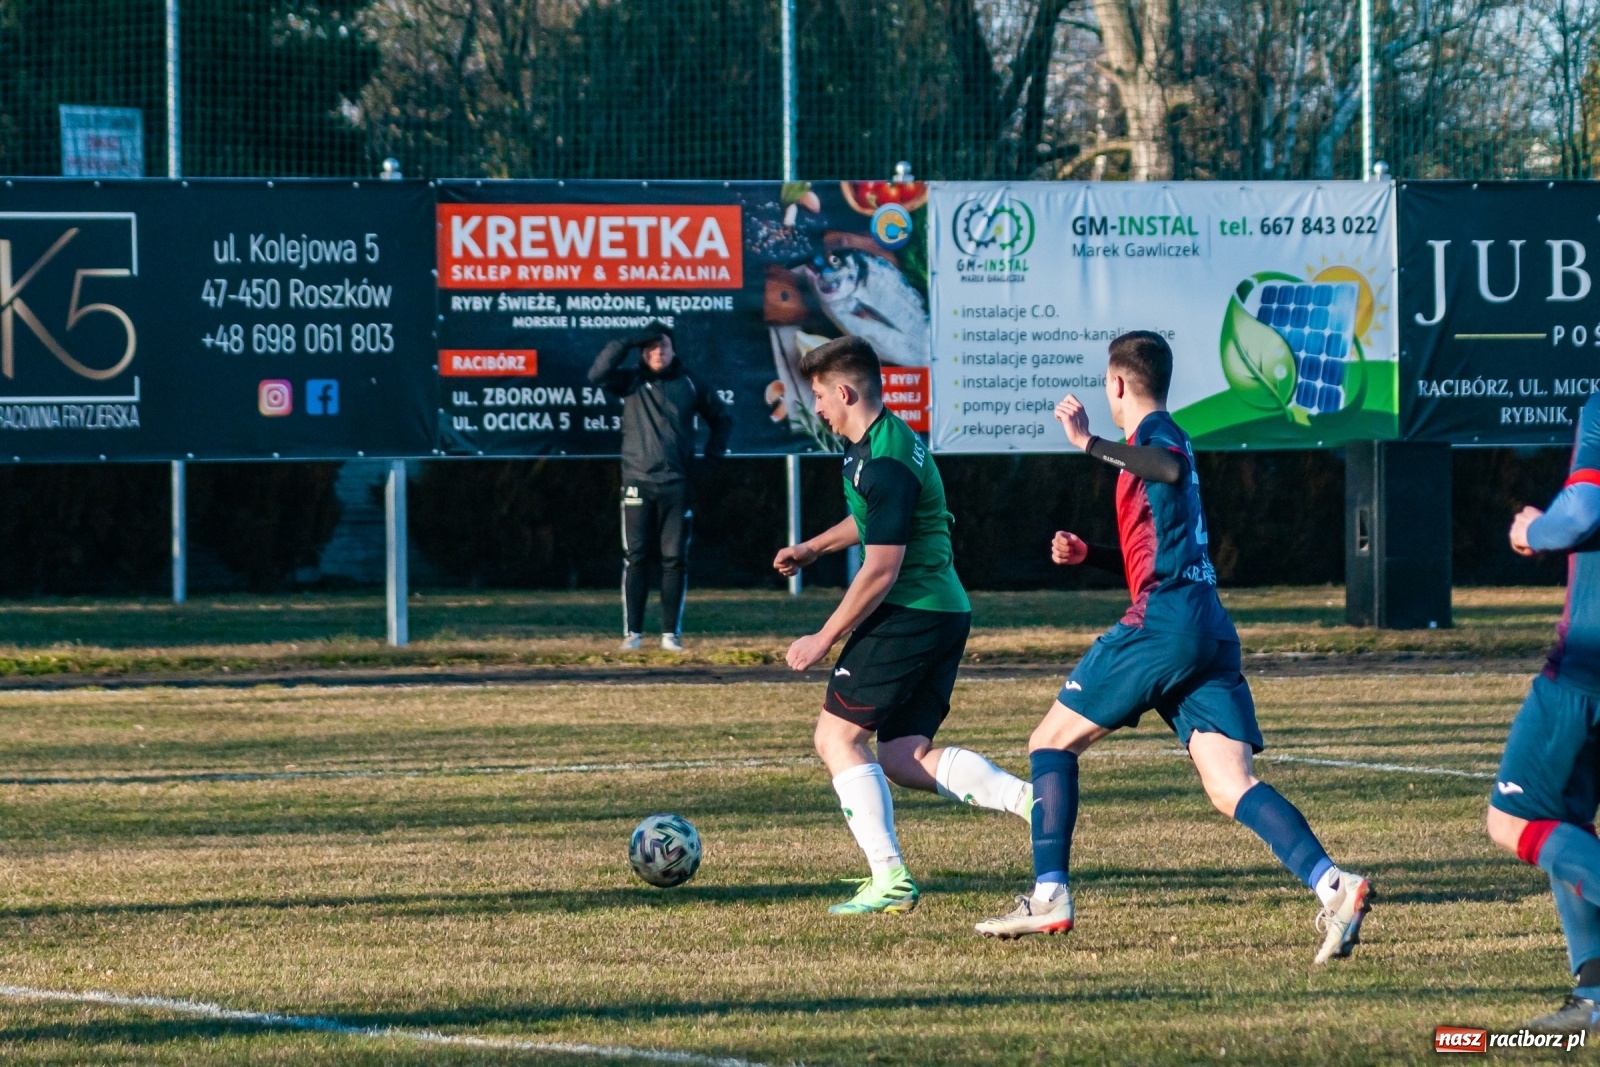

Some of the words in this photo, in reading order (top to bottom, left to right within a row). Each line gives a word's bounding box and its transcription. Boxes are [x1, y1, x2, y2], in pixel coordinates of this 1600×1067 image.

[1072, 216, 1200, 237] GM-INSTAL
[1220, 216, 1253, 236] tel.
[1260, 216, 1294, 236] 667
[1301, 216, 1336, 235] 843
[1343, 215, 1378, 235] 022
[451, 215, 730, 259] KREWETKA
[214, 233, 242, 264] ul.
[250, 233, 357, 269] Kolejowa
[365, 233, 380, 264] 5
[1072, 243, 1120, 258] Marek
[1125, 243, 1200, 258] Gawliczek
[451, 264, 511, 282] SKLEP
[518, 264, 582, 282] RYBNY
[593, 265, 607, 282] &
[618, 262, 730, 282] SMAŻALNIA
[957, 258, 1029, 272] GM-INSTAL
[201, 278, 281, 309] 47-450
[289, 277, 393, 309] Roszków
[451, 295, 493, 311] RYBY
[498, 292, 562, 314] ŚWIEŻE,
[566, 292, 651, 314] MROŻONE,
[655, 295, 734, 314] WĘDZONE
[962, 305, 1027, 320] instalacje
[1031, 305, 1060, 319] C.O.
[512, 316, 568, 329] MORSKIE
[201, 323, 244, 355] +48
[252, 323, 297, 354] 698
[304, 323, 343, 354] 061
[351, 322, 395, 354] 803
[962, 328, 1027, 344] instalacje
[452, 353, 527, 371] RACIBÓRZ
[962, 352, 1027, 367] instalacje
[1032, 354, 1084, 367] gazowe
[962, 375, 1027, 390] instalacje
[1417, 375, 1514, 398] RACIBÓRZ,
[1518, 378, 1548, 396] UL.
[483, 387, 577, 405] ZBOROWA
[582, 387, 606, 405] 5A
[883, 392, 921, 403] ASNEJ
[963, 401, 1010, 415] pompy
[1501, 406, 1573, 425] RYBNIK,
[483, 412, 554, 431] OCICKA
[559, 412, 571, 431] 5
[963, 421, 1045, 438] rekuperacja
